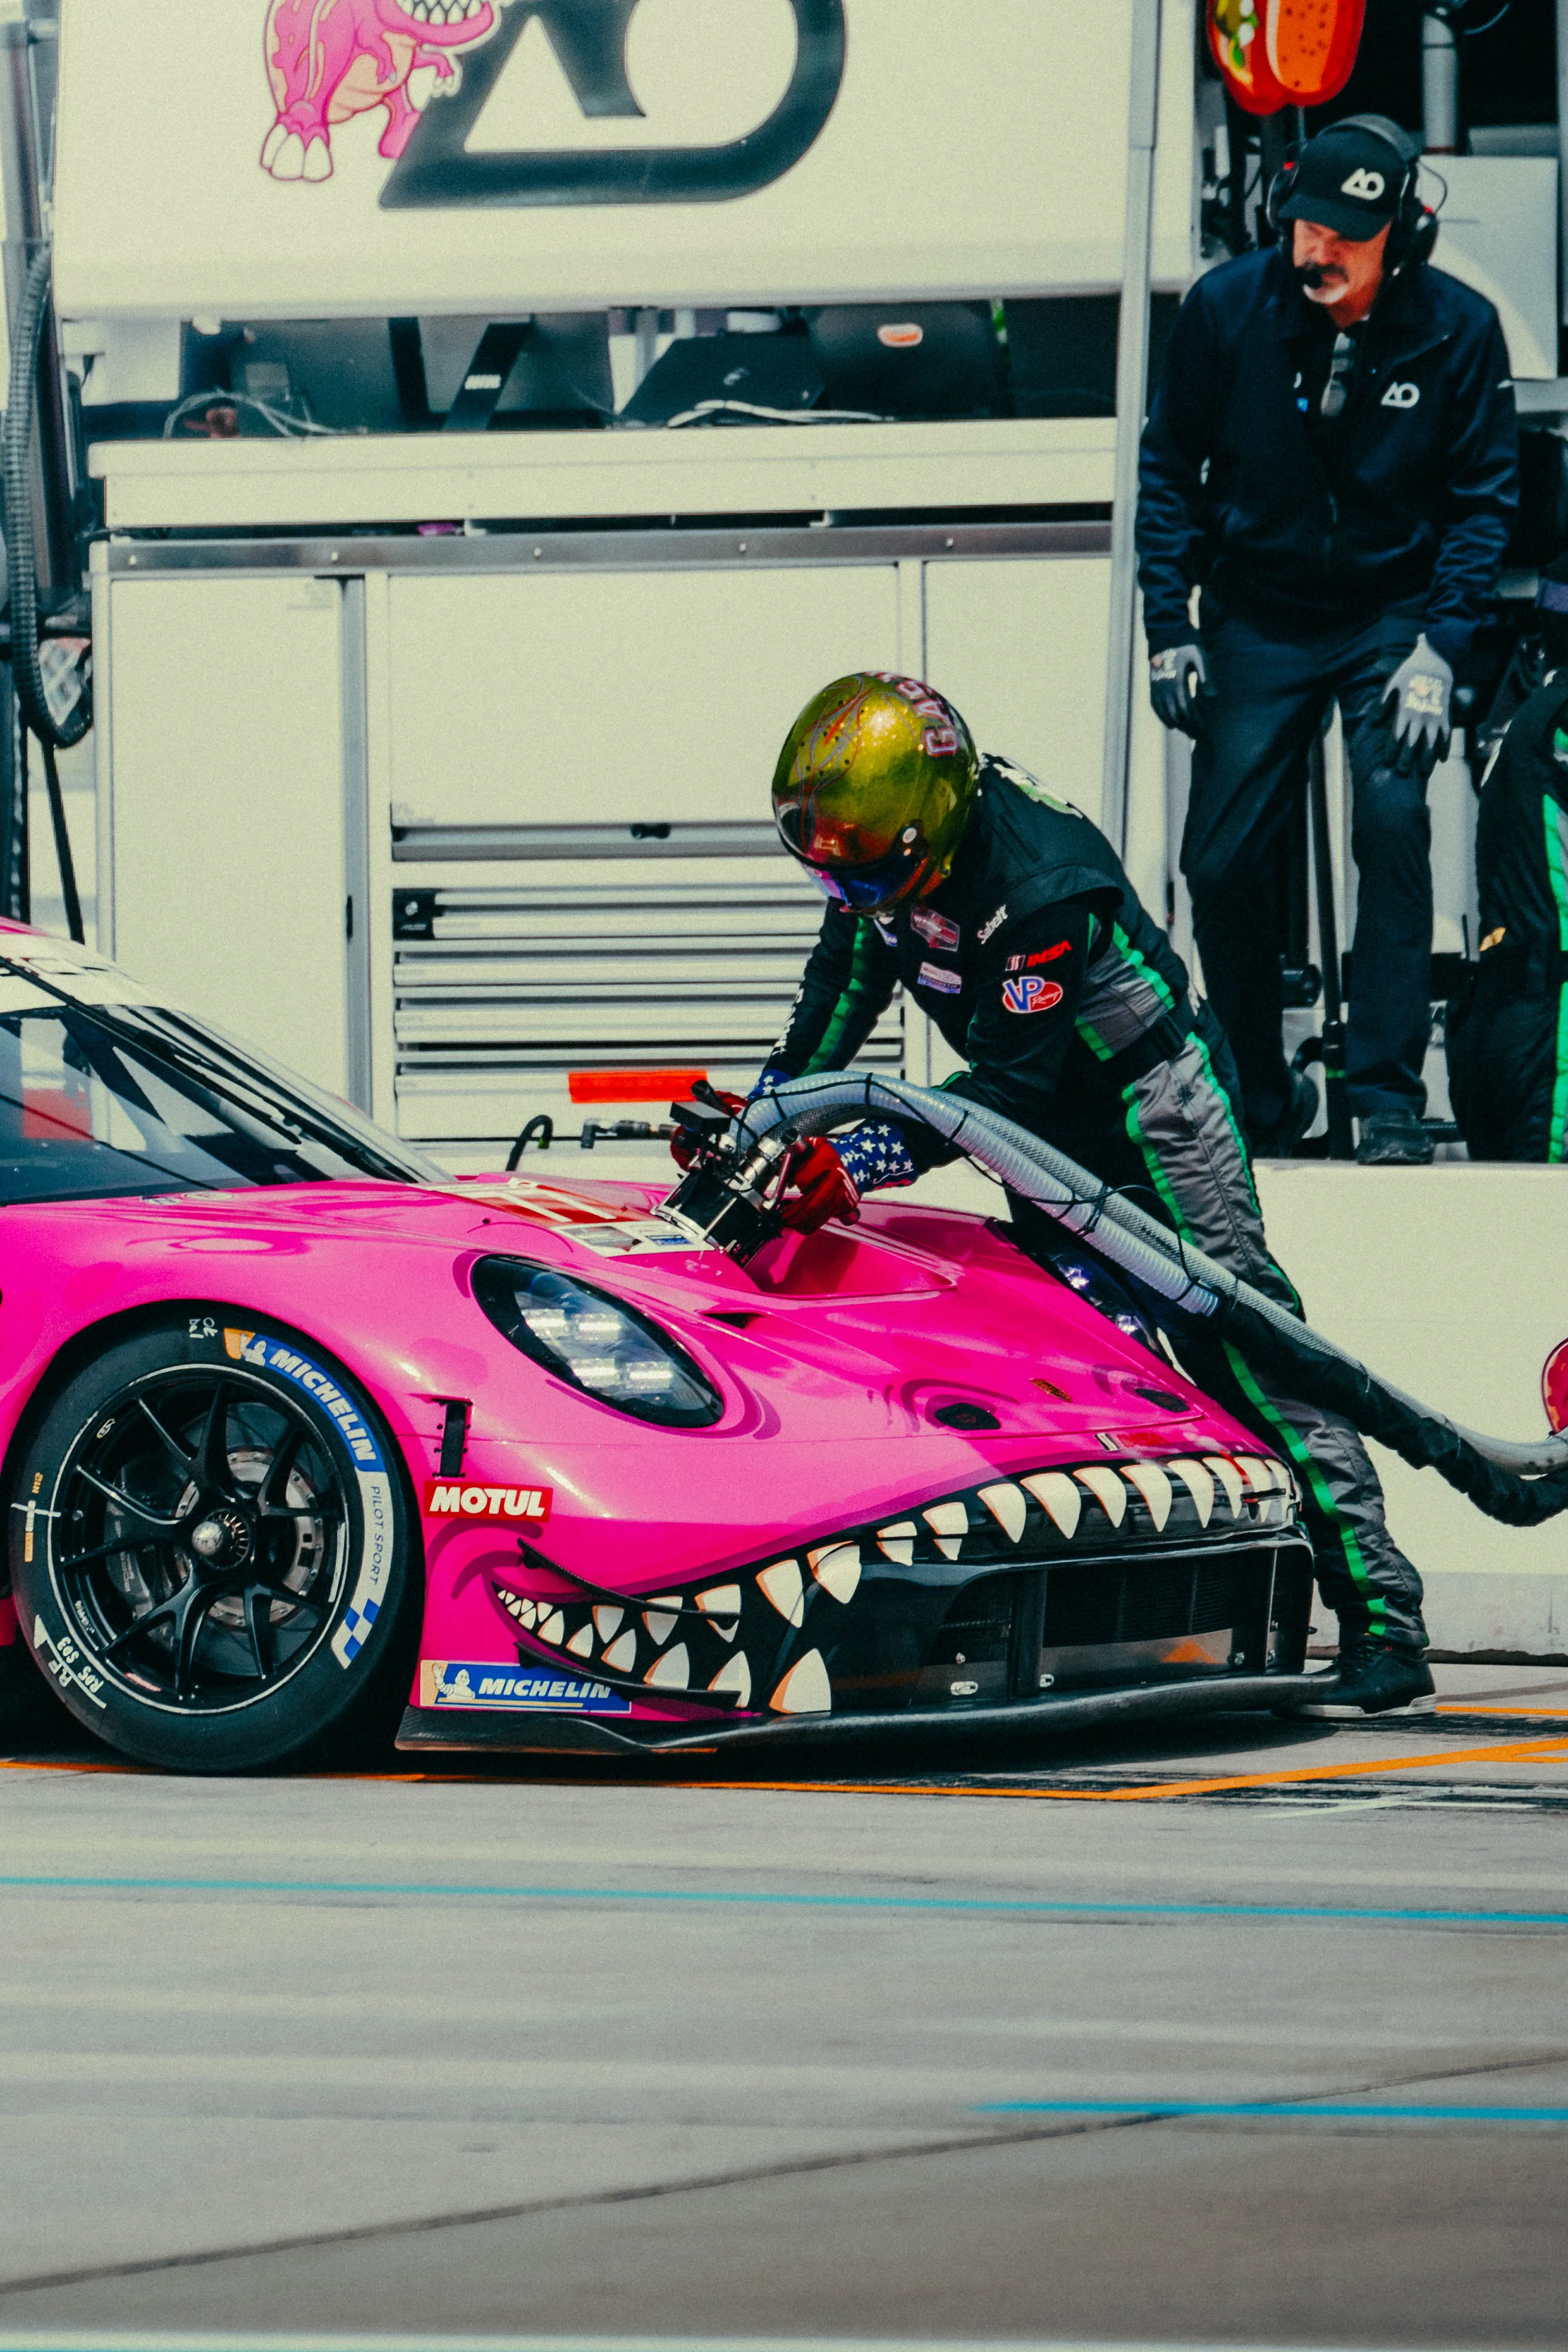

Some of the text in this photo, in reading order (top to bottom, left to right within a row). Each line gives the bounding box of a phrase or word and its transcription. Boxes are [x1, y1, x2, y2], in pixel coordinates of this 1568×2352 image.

[976, 904, 1009, 945] Sabelt
[1025, 940, 1072, 967] IMSA
[1002, 976, 1046, 1012] VP
[1031, 990, 1062, 1007] Racing
[269, 1348, 377, 1462] MICHELIN
[429, 1486, 546, 1517] MOTUL
[369, 1486, 384, 1586] PILOT SPORT
[478, 1677, 611, 1699] MICHELIN
